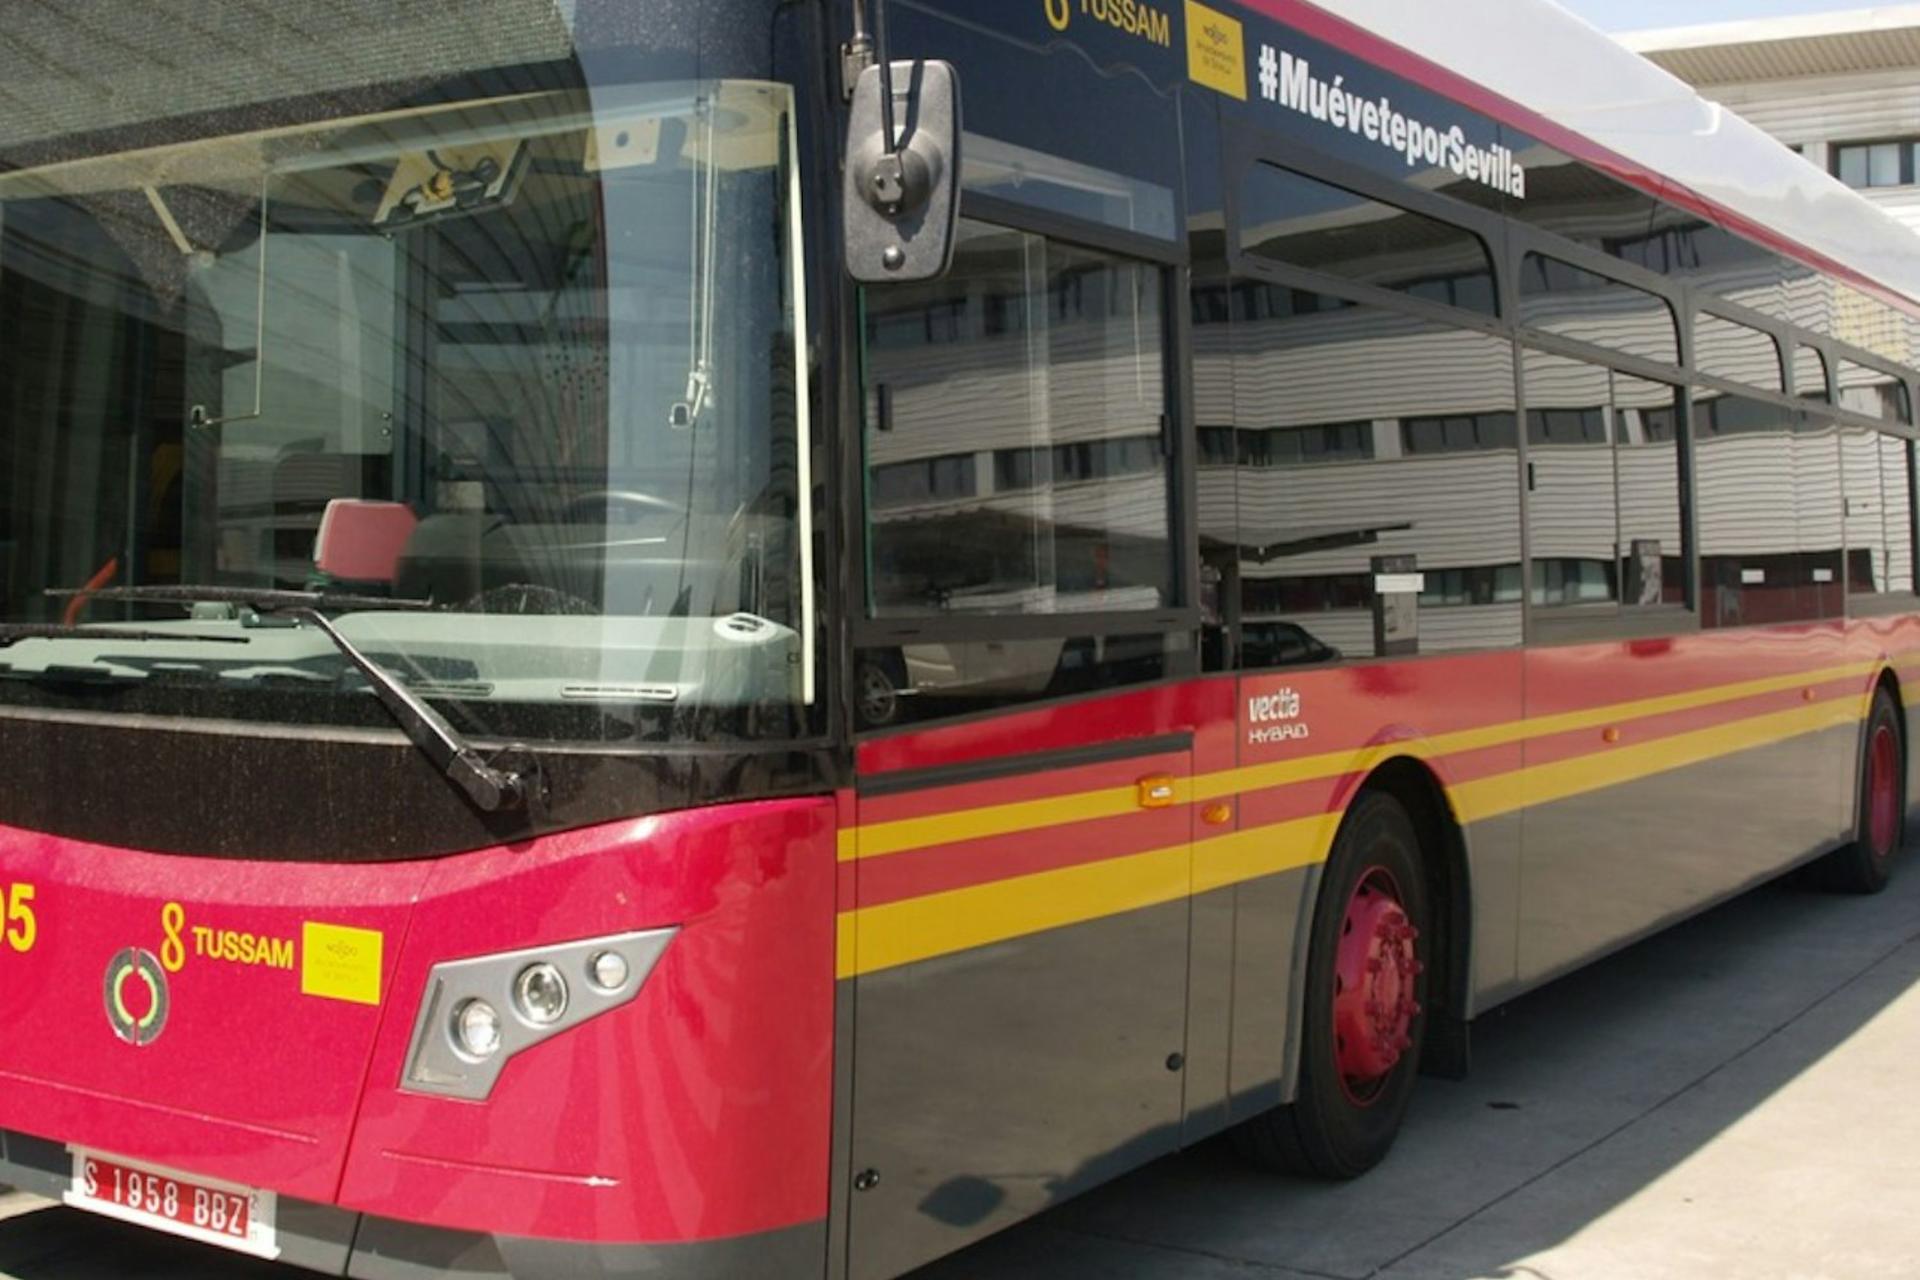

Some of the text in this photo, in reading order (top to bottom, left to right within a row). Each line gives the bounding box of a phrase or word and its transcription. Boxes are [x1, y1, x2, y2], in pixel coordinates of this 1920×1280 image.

[1258, 44, 1526, 199] #MuéveteporSevilla
[1249, 687, 1300, 722] vectia
[0, 883, 36, 952] 5
[191, 926, 294, 970] TUSSAM
[84, 1161, 98, 1196] S
[194, 1188, 244, 1236] BBZ
